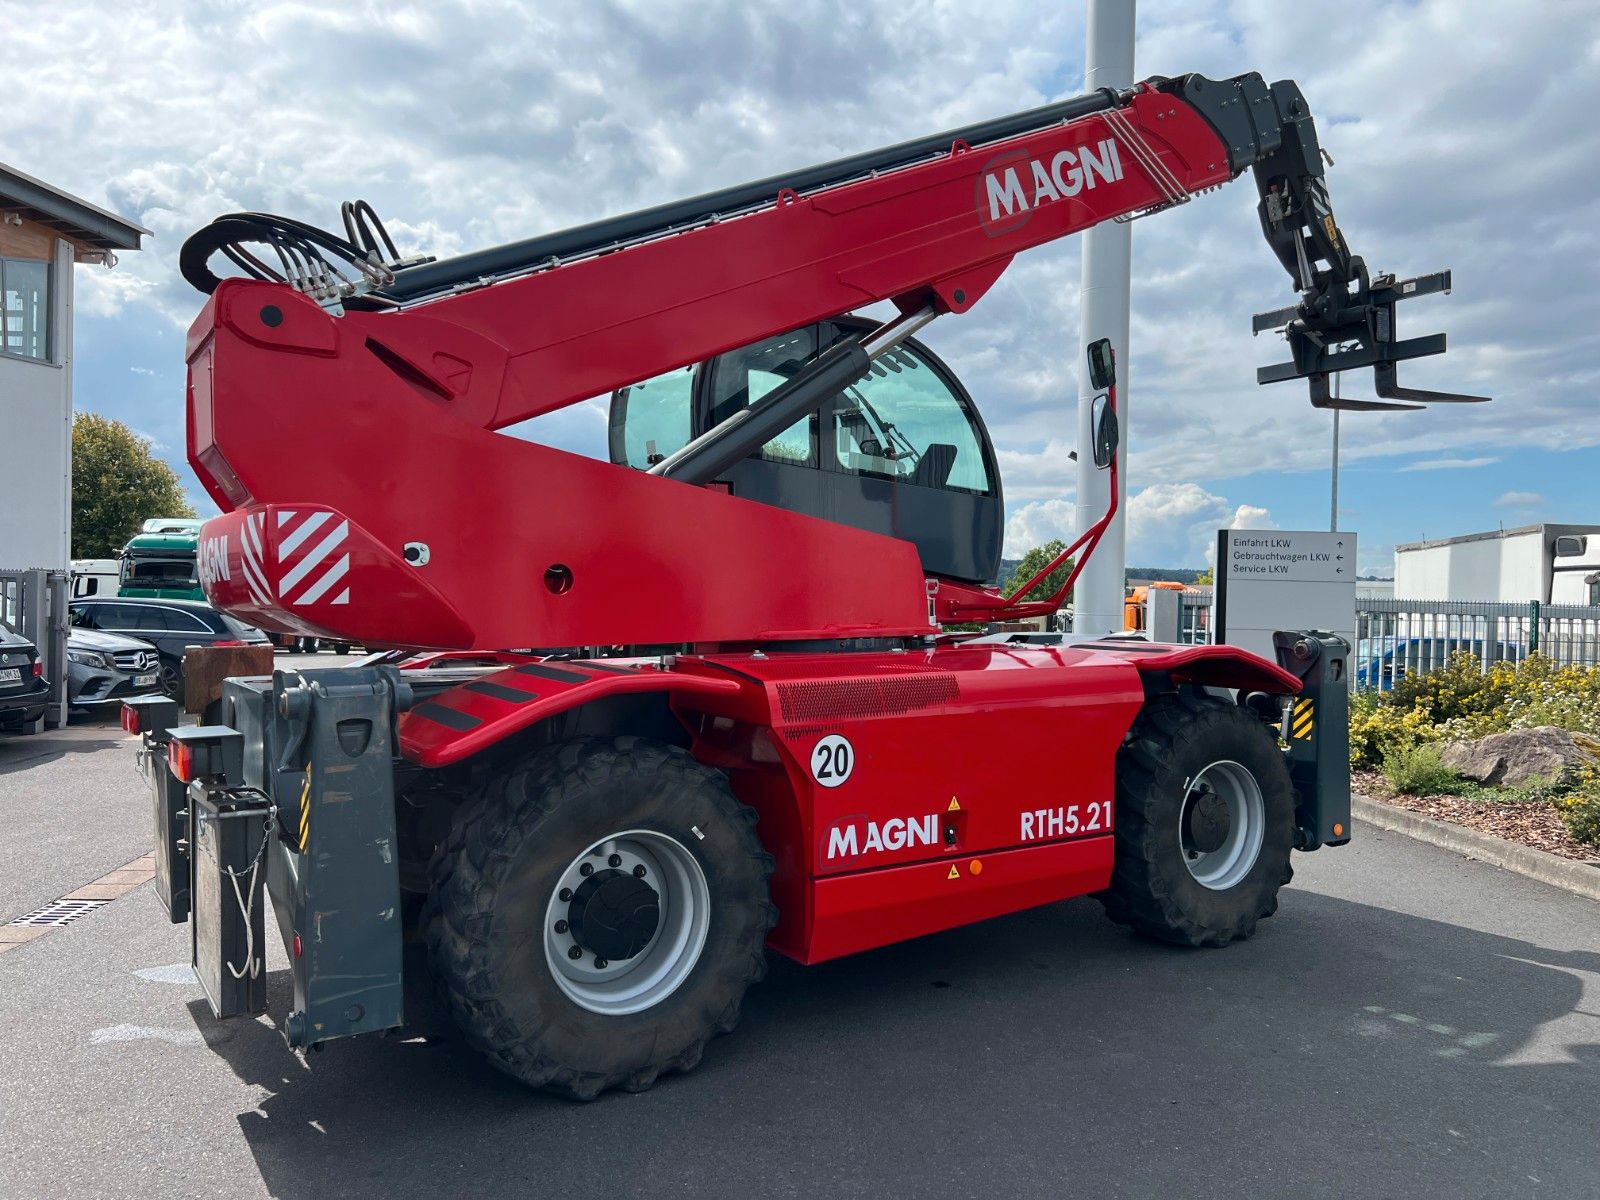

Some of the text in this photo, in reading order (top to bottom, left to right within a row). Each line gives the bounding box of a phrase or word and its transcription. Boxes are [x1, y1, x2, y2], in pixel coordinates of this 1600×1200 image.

[985, 138, 1124, 221] MAGNI
[1233, 538, 1291, 548] Einfahrt LKW
[1233, 551, 1330, 562] Gebrauchtwagen LKW
[1233, 564, 1289, 574] Service LKW
[816, 743, 849, 779] 20
[827, 814, 939, 859] MAGNI
[1020, 800, 1112, 841] RTH5.21
